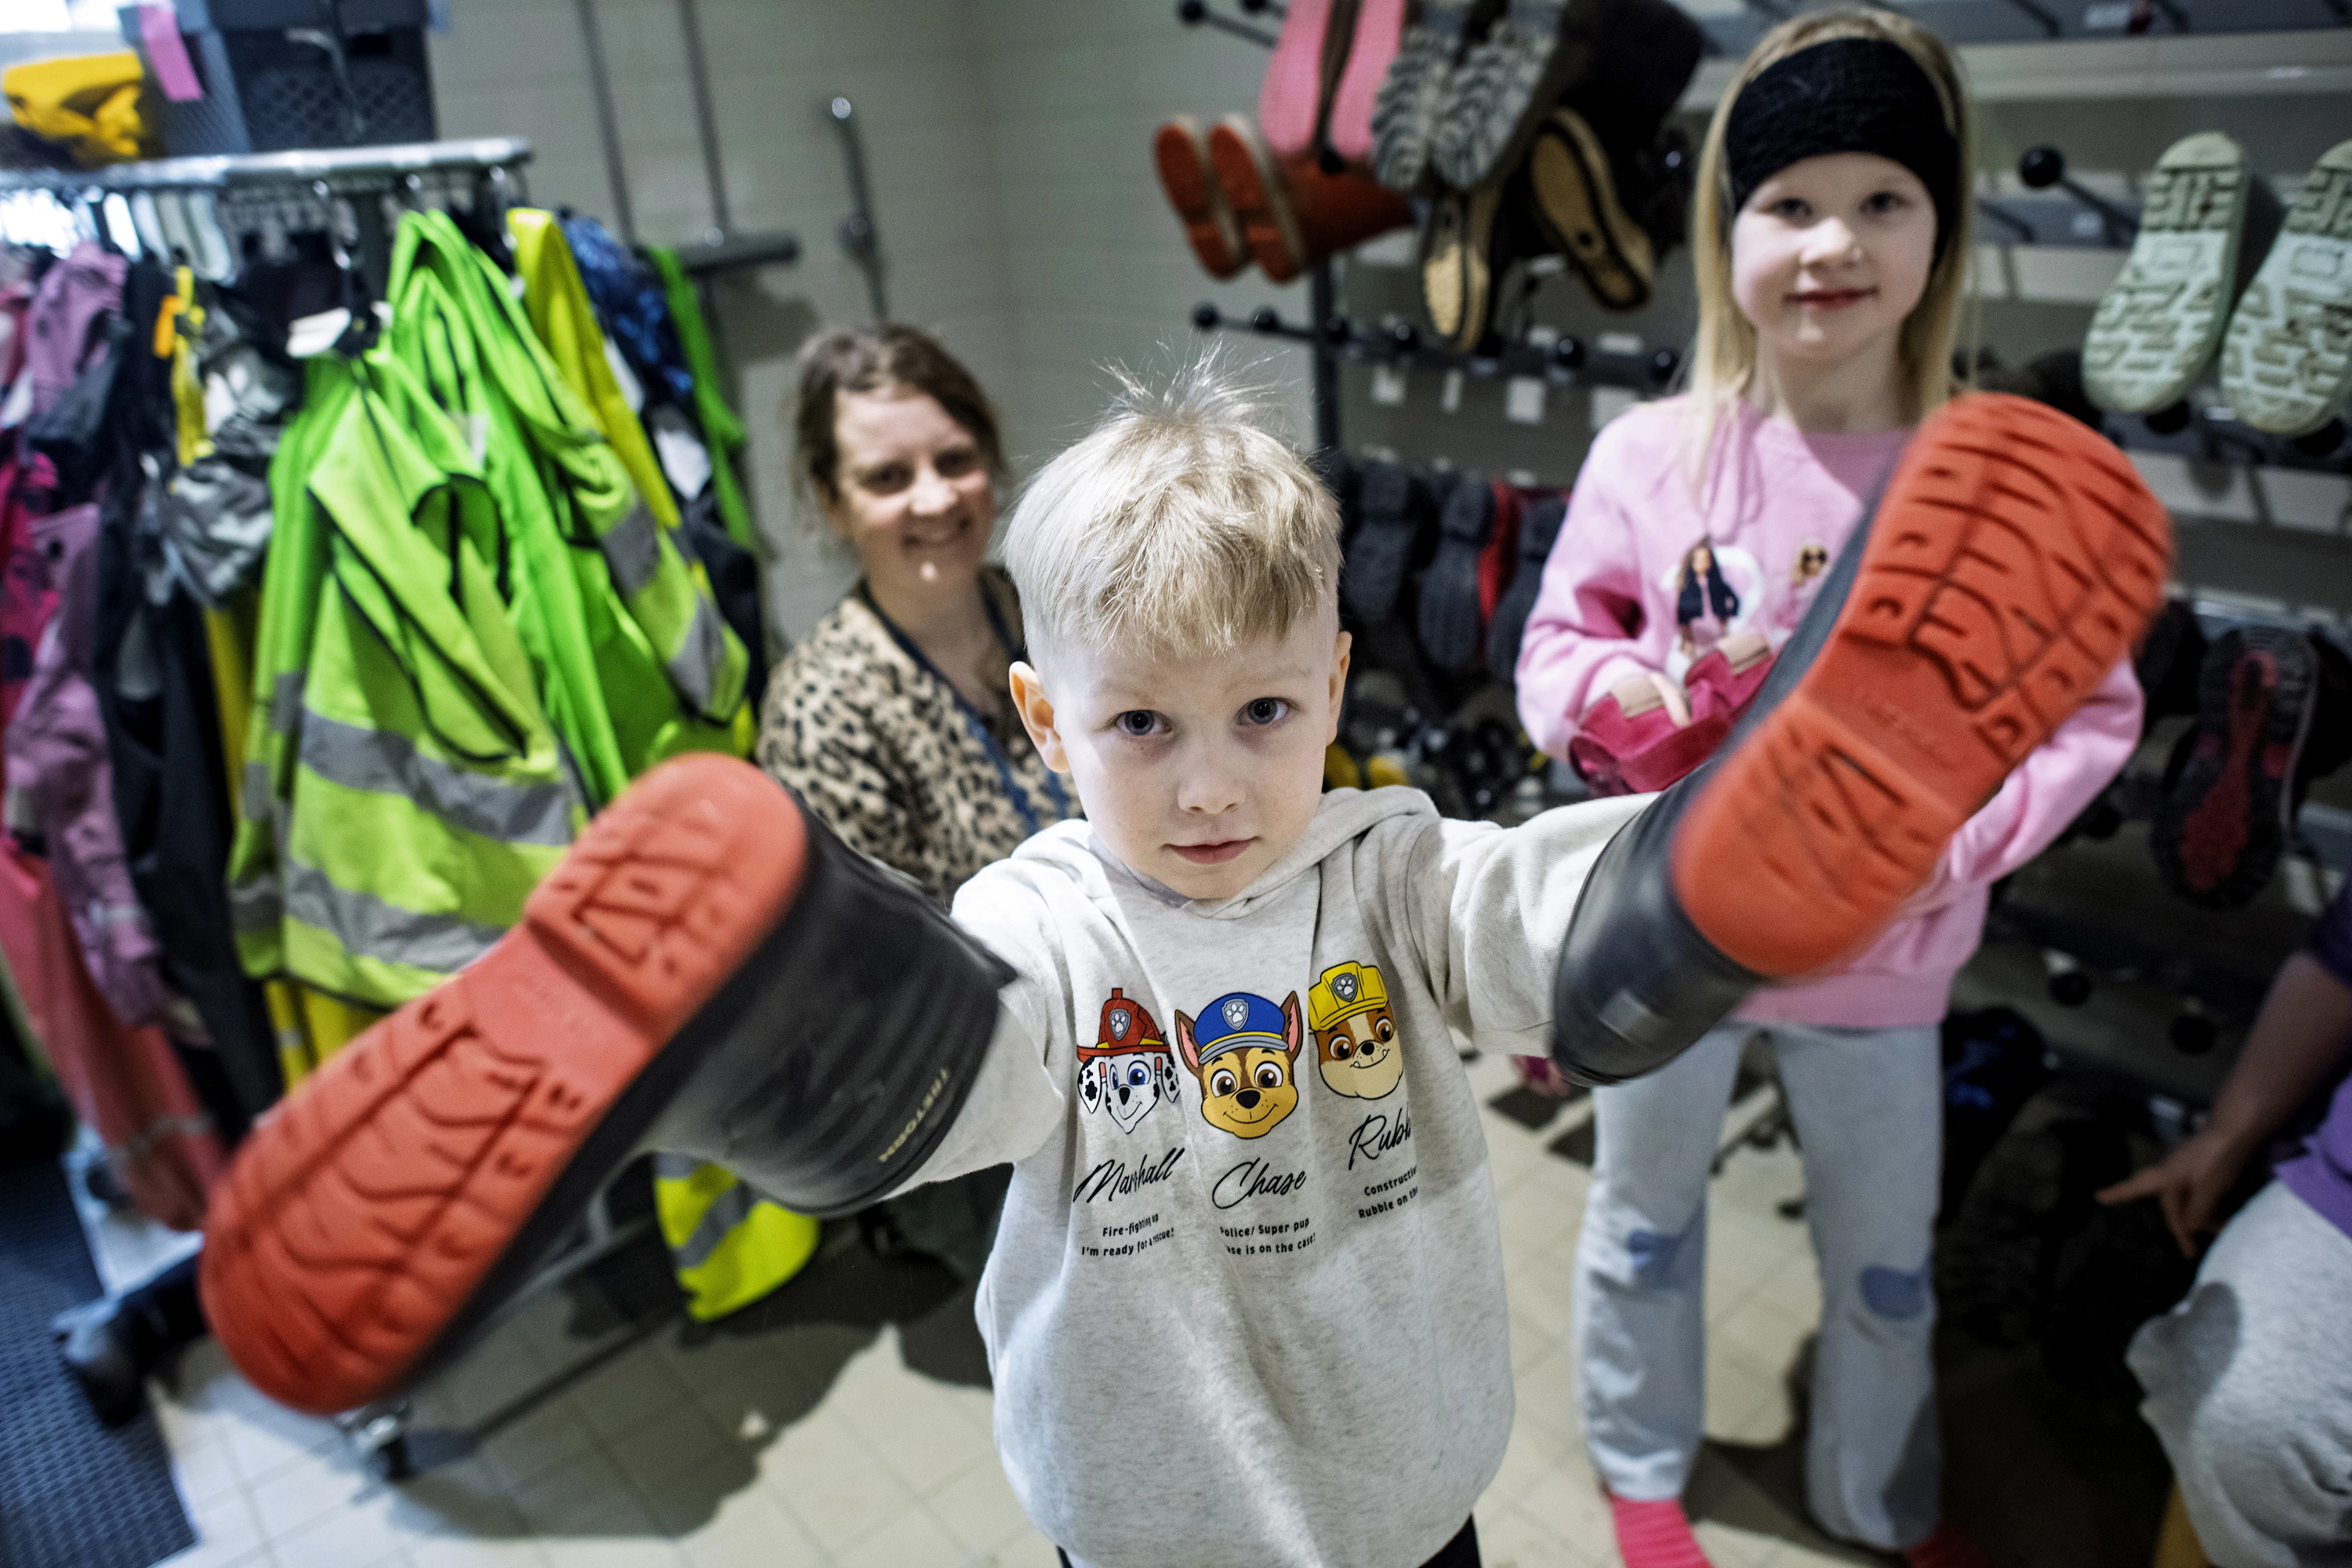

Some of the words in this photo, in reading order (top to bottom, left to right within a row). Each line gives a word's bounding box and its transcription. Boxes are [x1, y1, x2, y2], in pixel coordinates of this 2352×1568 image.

[1073, 1148, 1185, 1203] Marshall
[1212, 1157, 1306, 1209] Chase
[1359, 1201, 1394, 1219] Rubble
[1396, 1194, 1408, 1206] on
[1152, 1213, 1159, 1224] up
[1258, 1224, 1290, 1236] Super
[1294, 1218, 1309, 1232] pup
[1082, 1246, 1098, 1256] I'm
[1103, 1244, 1134, 1256] ready
[1137, 1240, 1148, 1253] for
[1246, 1245, 1255, 1254] is
[1259, 1244, 1272, 1253] on
[1276, 1243, 1293, 1254] the
[1298, 1232, 1316, 1250] case!
